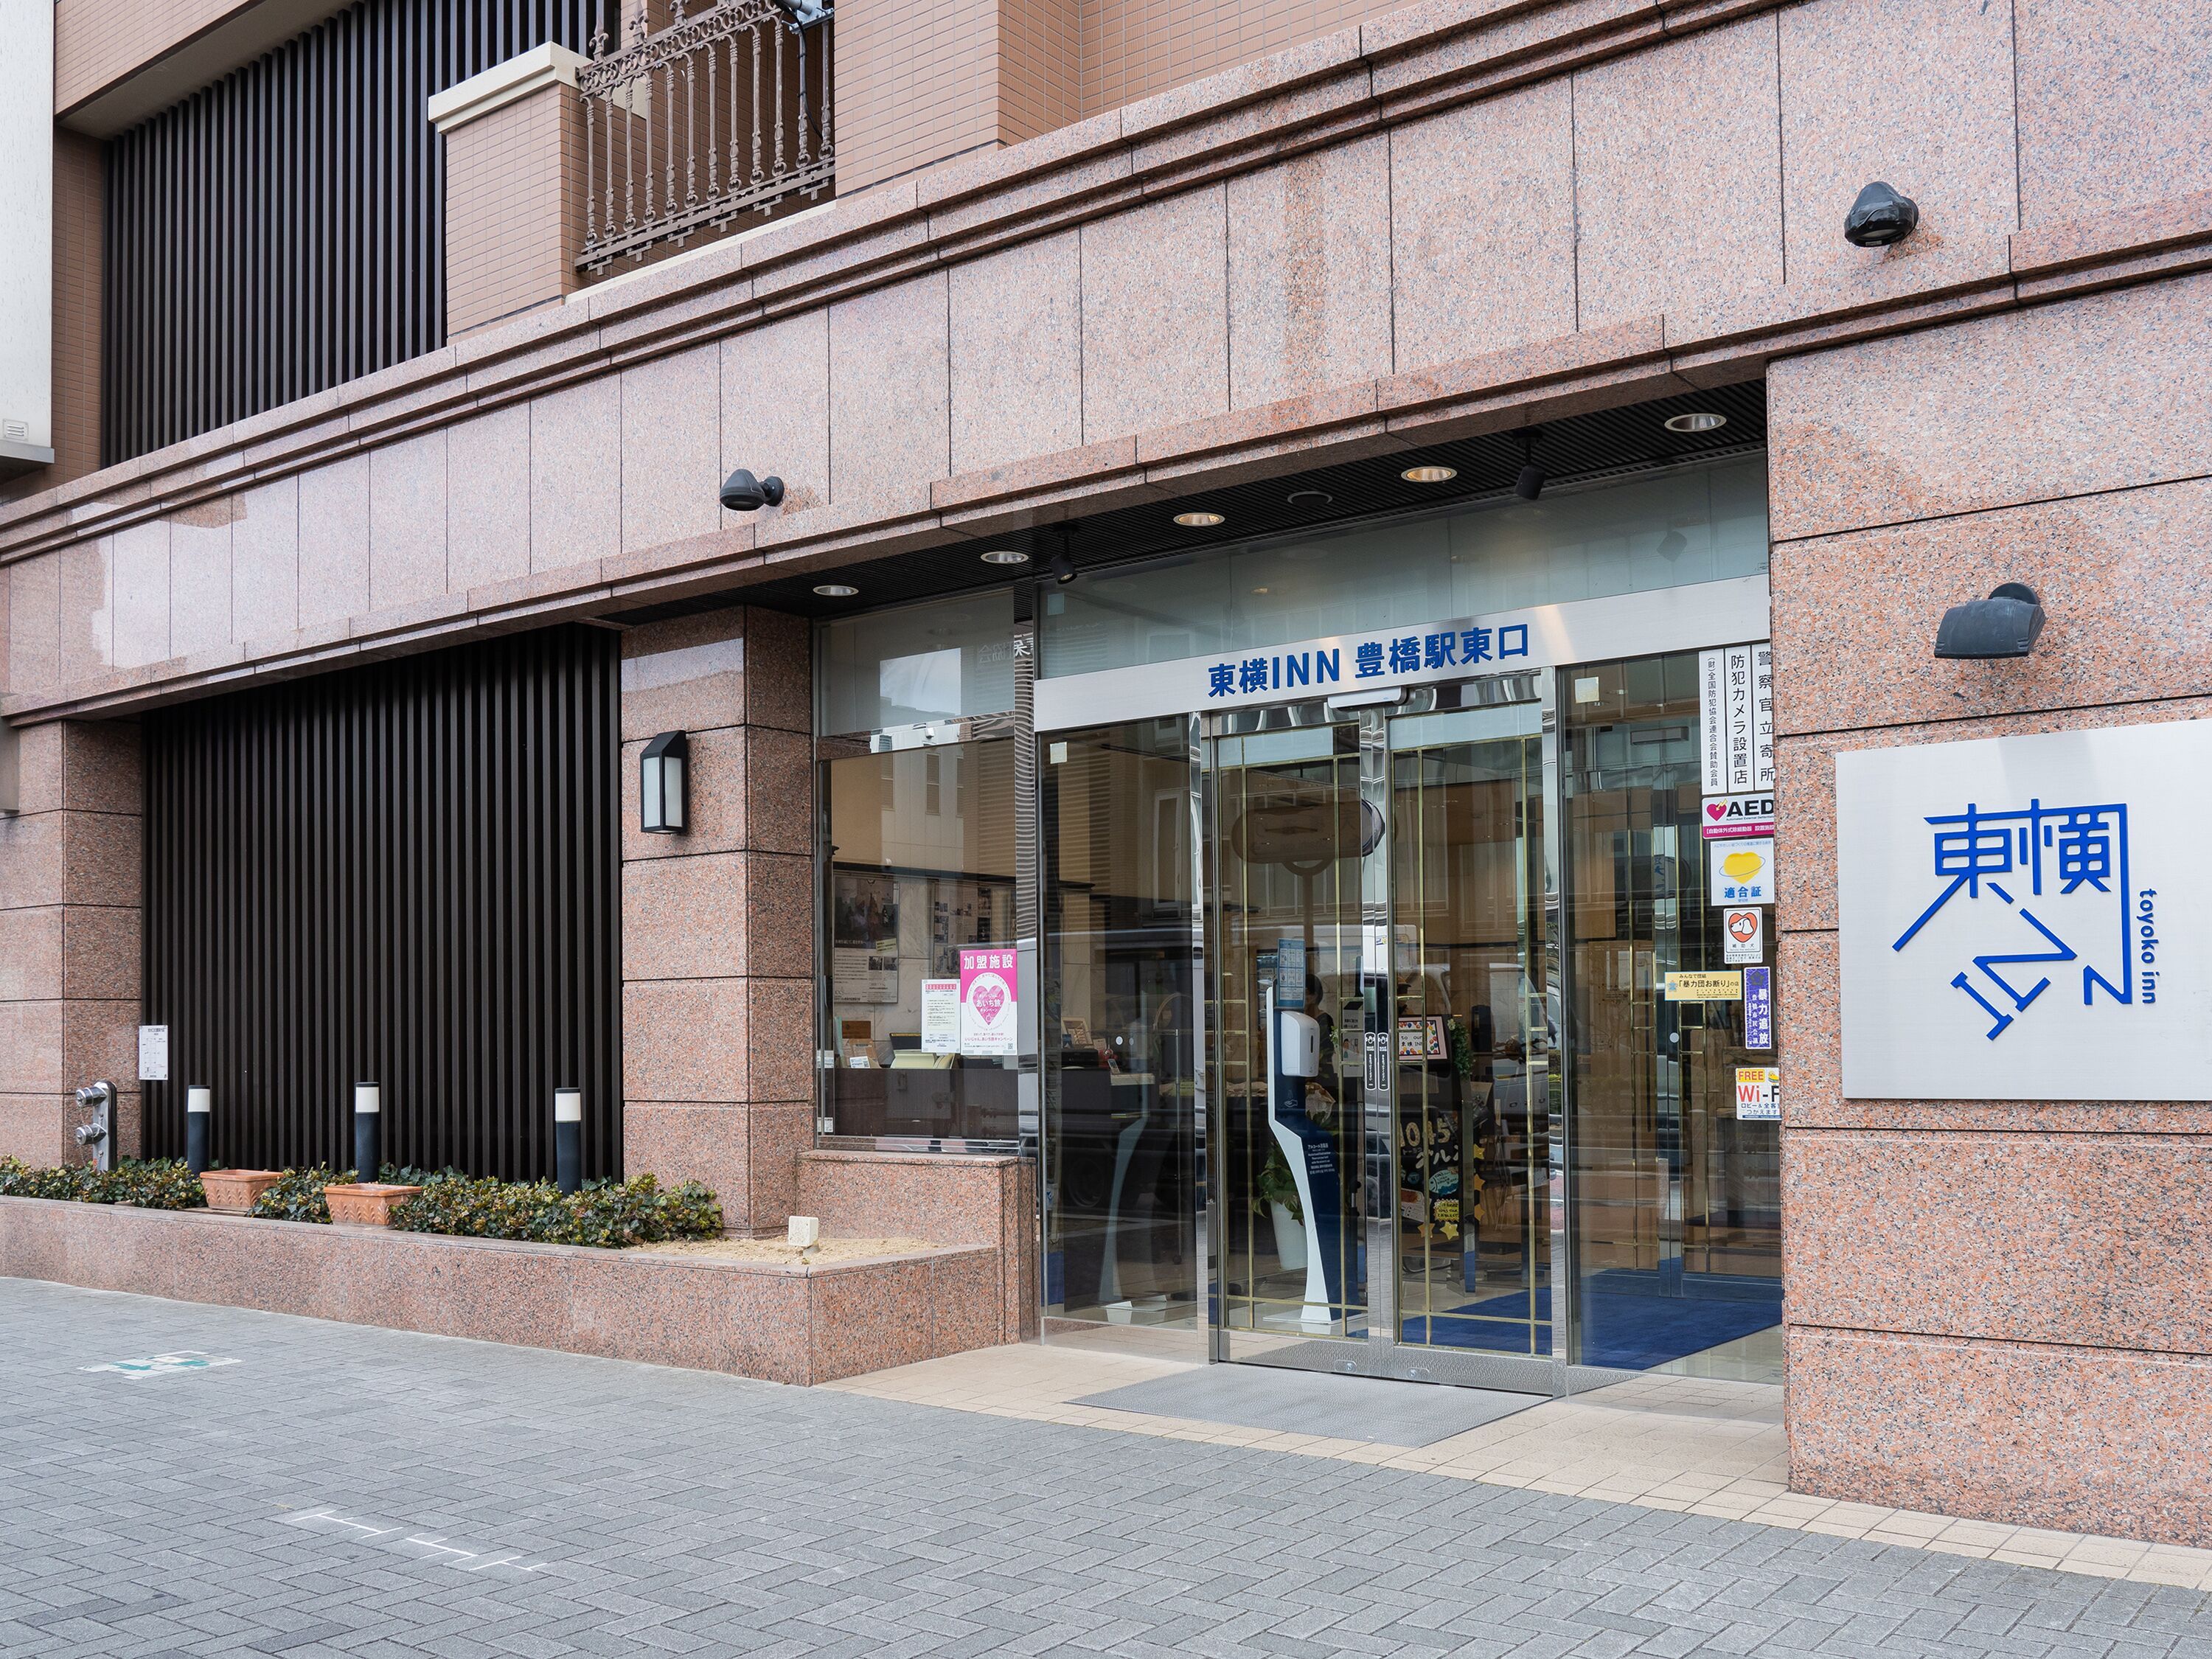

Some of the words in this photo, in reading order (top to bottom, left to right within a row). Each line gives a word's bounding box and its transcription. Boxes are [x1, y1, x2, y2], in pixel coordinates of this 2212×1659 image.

[1208, 649, 1340, 697] 東横INN
[1354, 624, 1529, 679] 豊橋駅東口
[1731, 654, 1747, 785] 防犯カメラ設置店
[1758, 650, 1774, 782] 警察官立寄所
[1726, 799, 1774, 817] AED
[1724, 886, 1762, 898] 適合証
[2136, 888, 2159, 964] toyoko
[964, 954, 1014, 970] 加盟施設
[1679, 979, 1739, 988] 「暴力団お断り」の店
[2141, 971, 2160, 1004] inn
[1758, 988, 1769, 1045] 暴力追放
[1738, 1071, 1764, 1081] FREE
[1738, 1085, 1779, 1102] Wi-F
